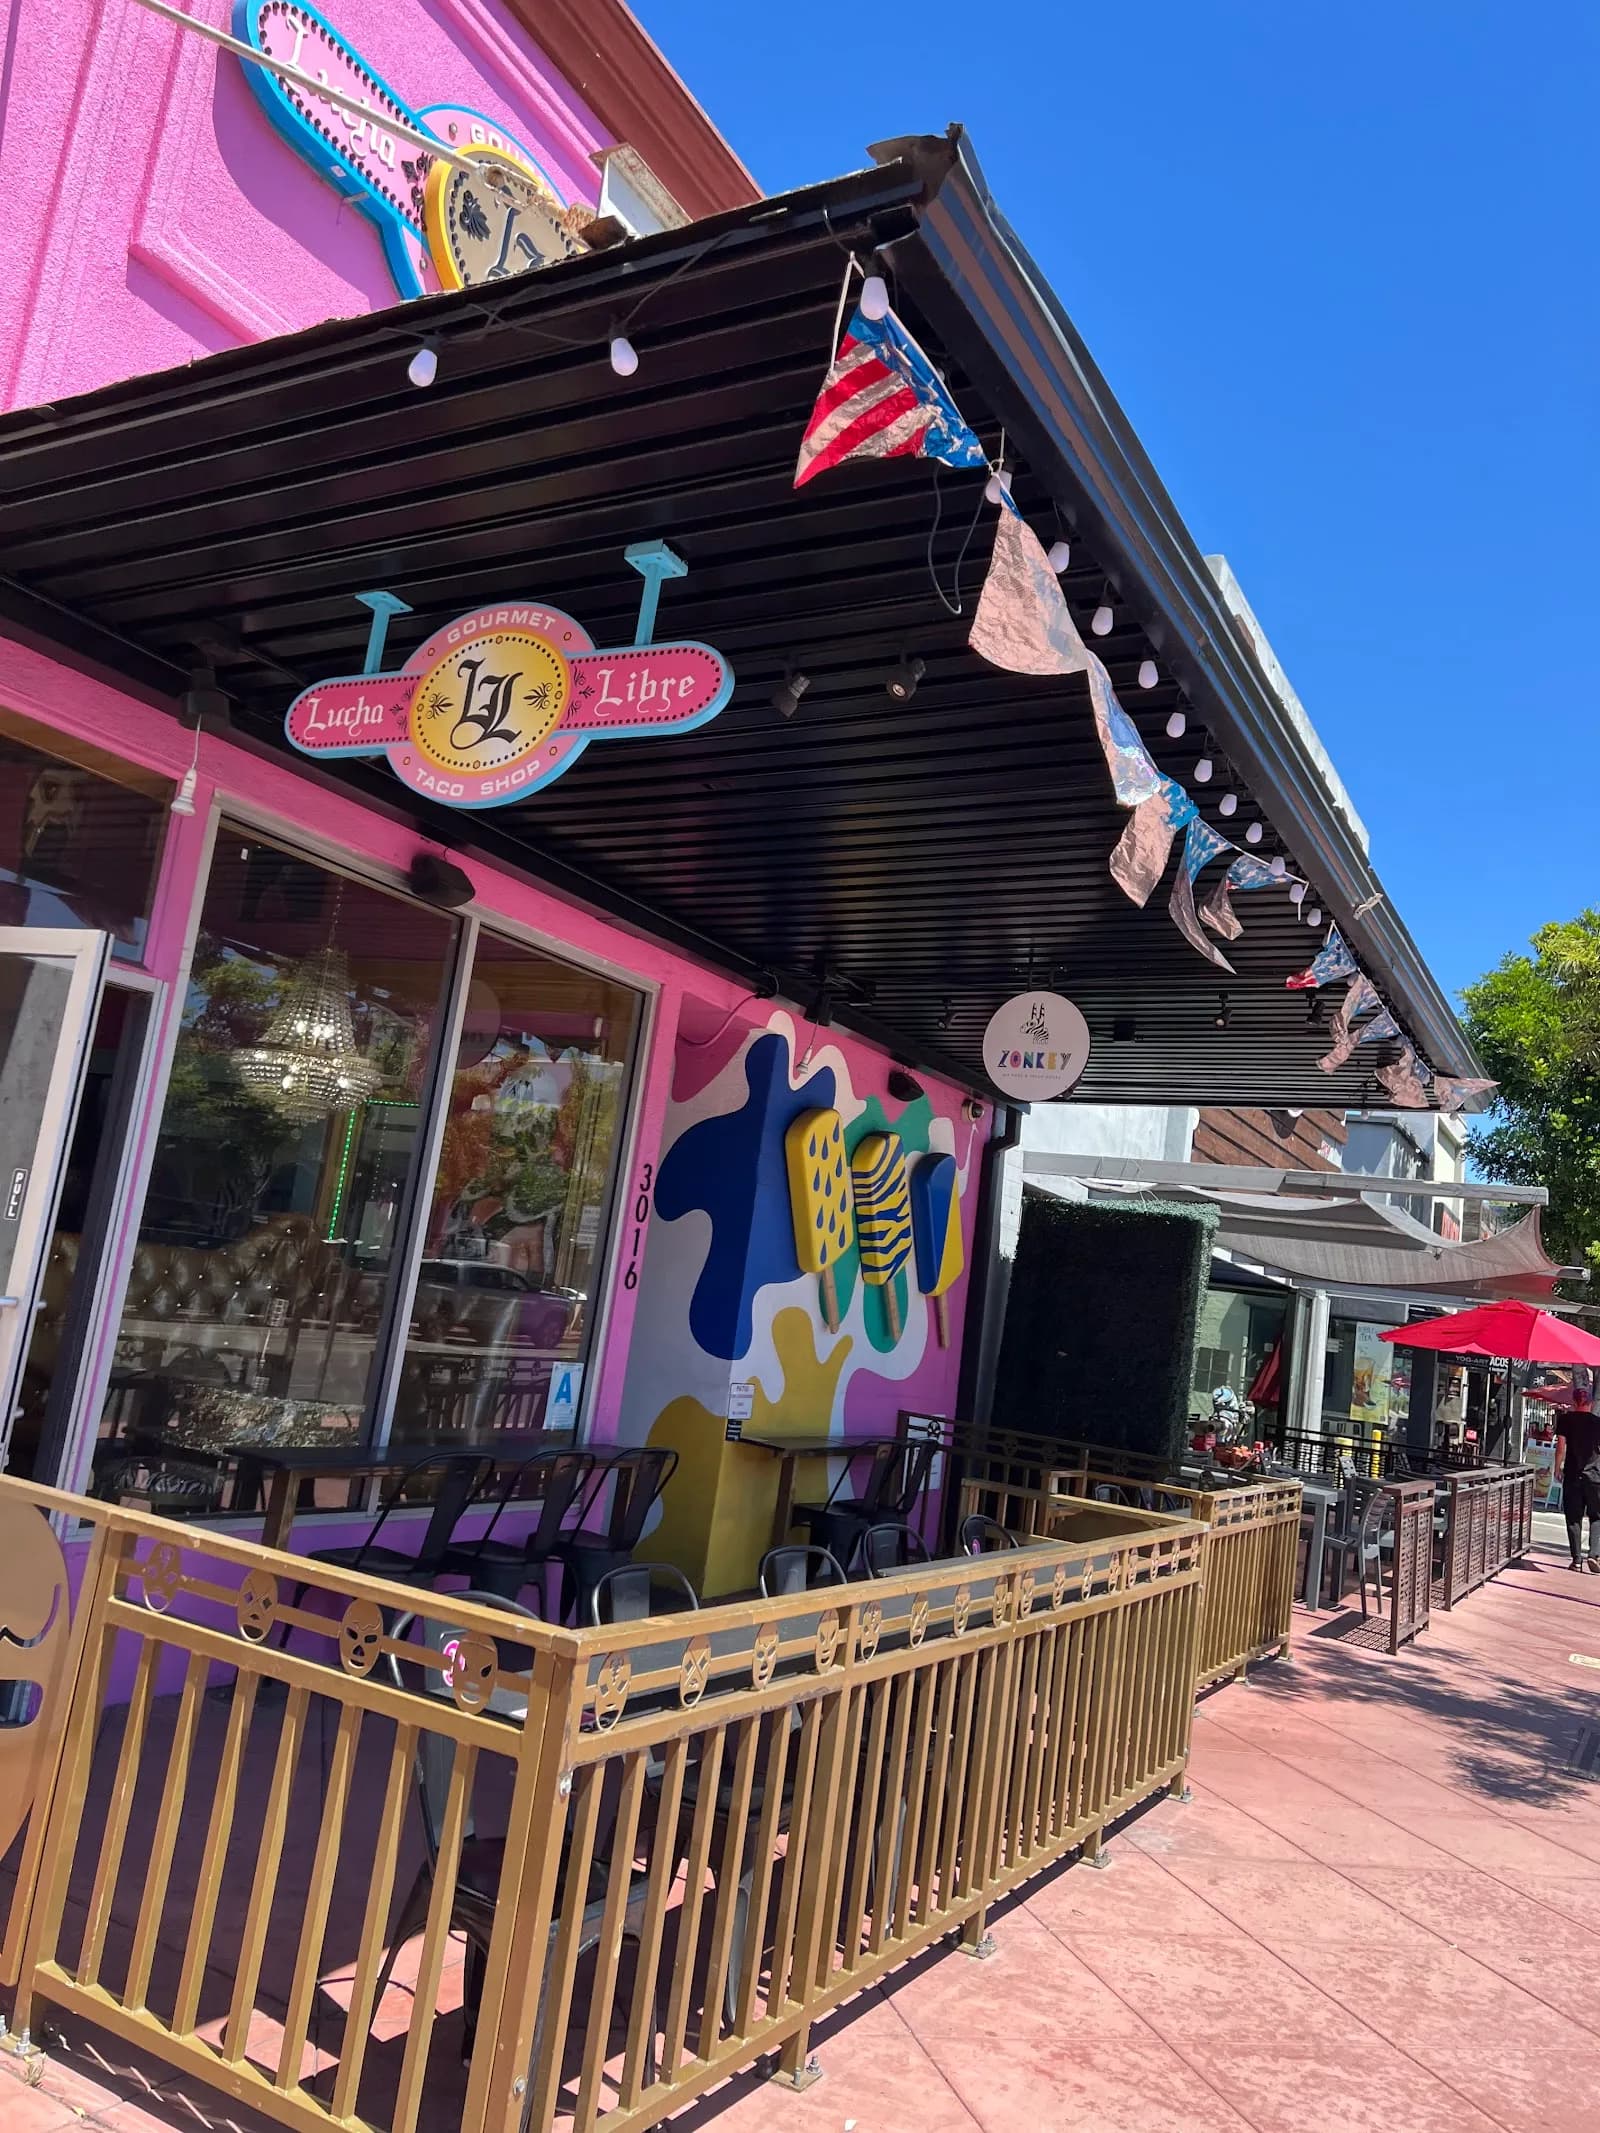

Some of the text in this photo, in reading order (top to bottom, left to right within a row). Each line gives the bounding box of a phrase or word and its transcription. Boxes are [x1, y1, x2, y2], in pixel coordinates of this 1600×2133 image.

[447, 610, 557, 644] GOURMET
[302, 668, 696, 740] Lucha Libre
[415, 759, 541, 798] TACO SHOP
[997, 1049, 1072, 1071] ZONKEY
[7, 1172, 24, 1218] PULL
[624, 1163, 653, 1290] 3016
[554, 1371, 572, 1404] A
